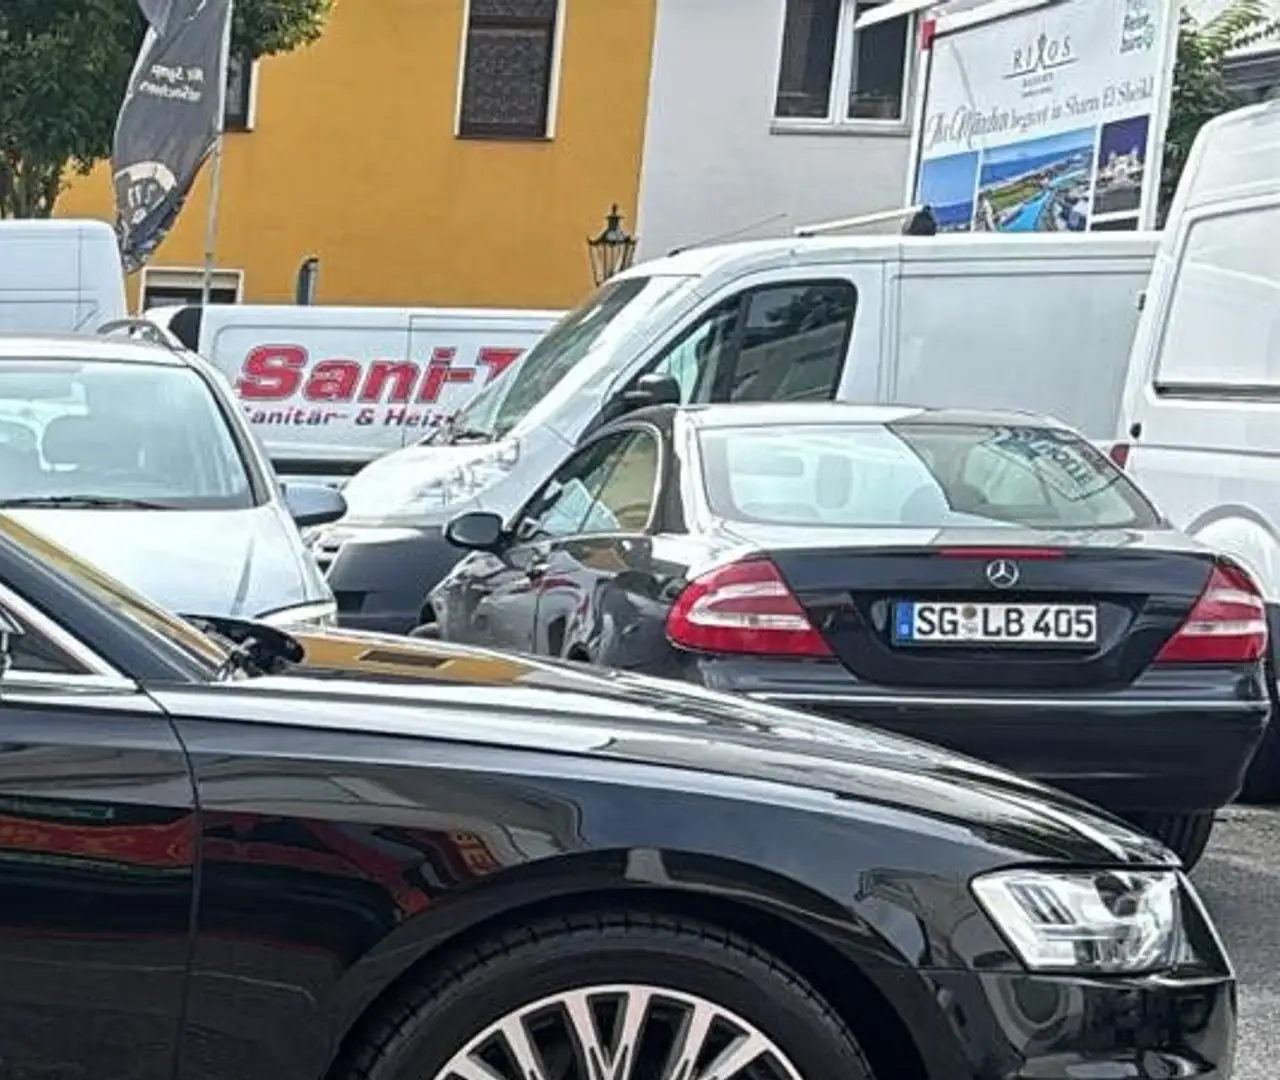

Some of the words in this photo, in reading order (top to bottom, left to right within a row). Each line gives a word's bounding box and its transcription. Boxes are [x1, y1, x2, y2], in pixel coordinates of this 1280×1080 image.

[355, 407, 375, 426] &
[917, 607, 958, 635] SG
[982, 608, 1025, 637] LB
[1033, 609, 1094, 637] 405
